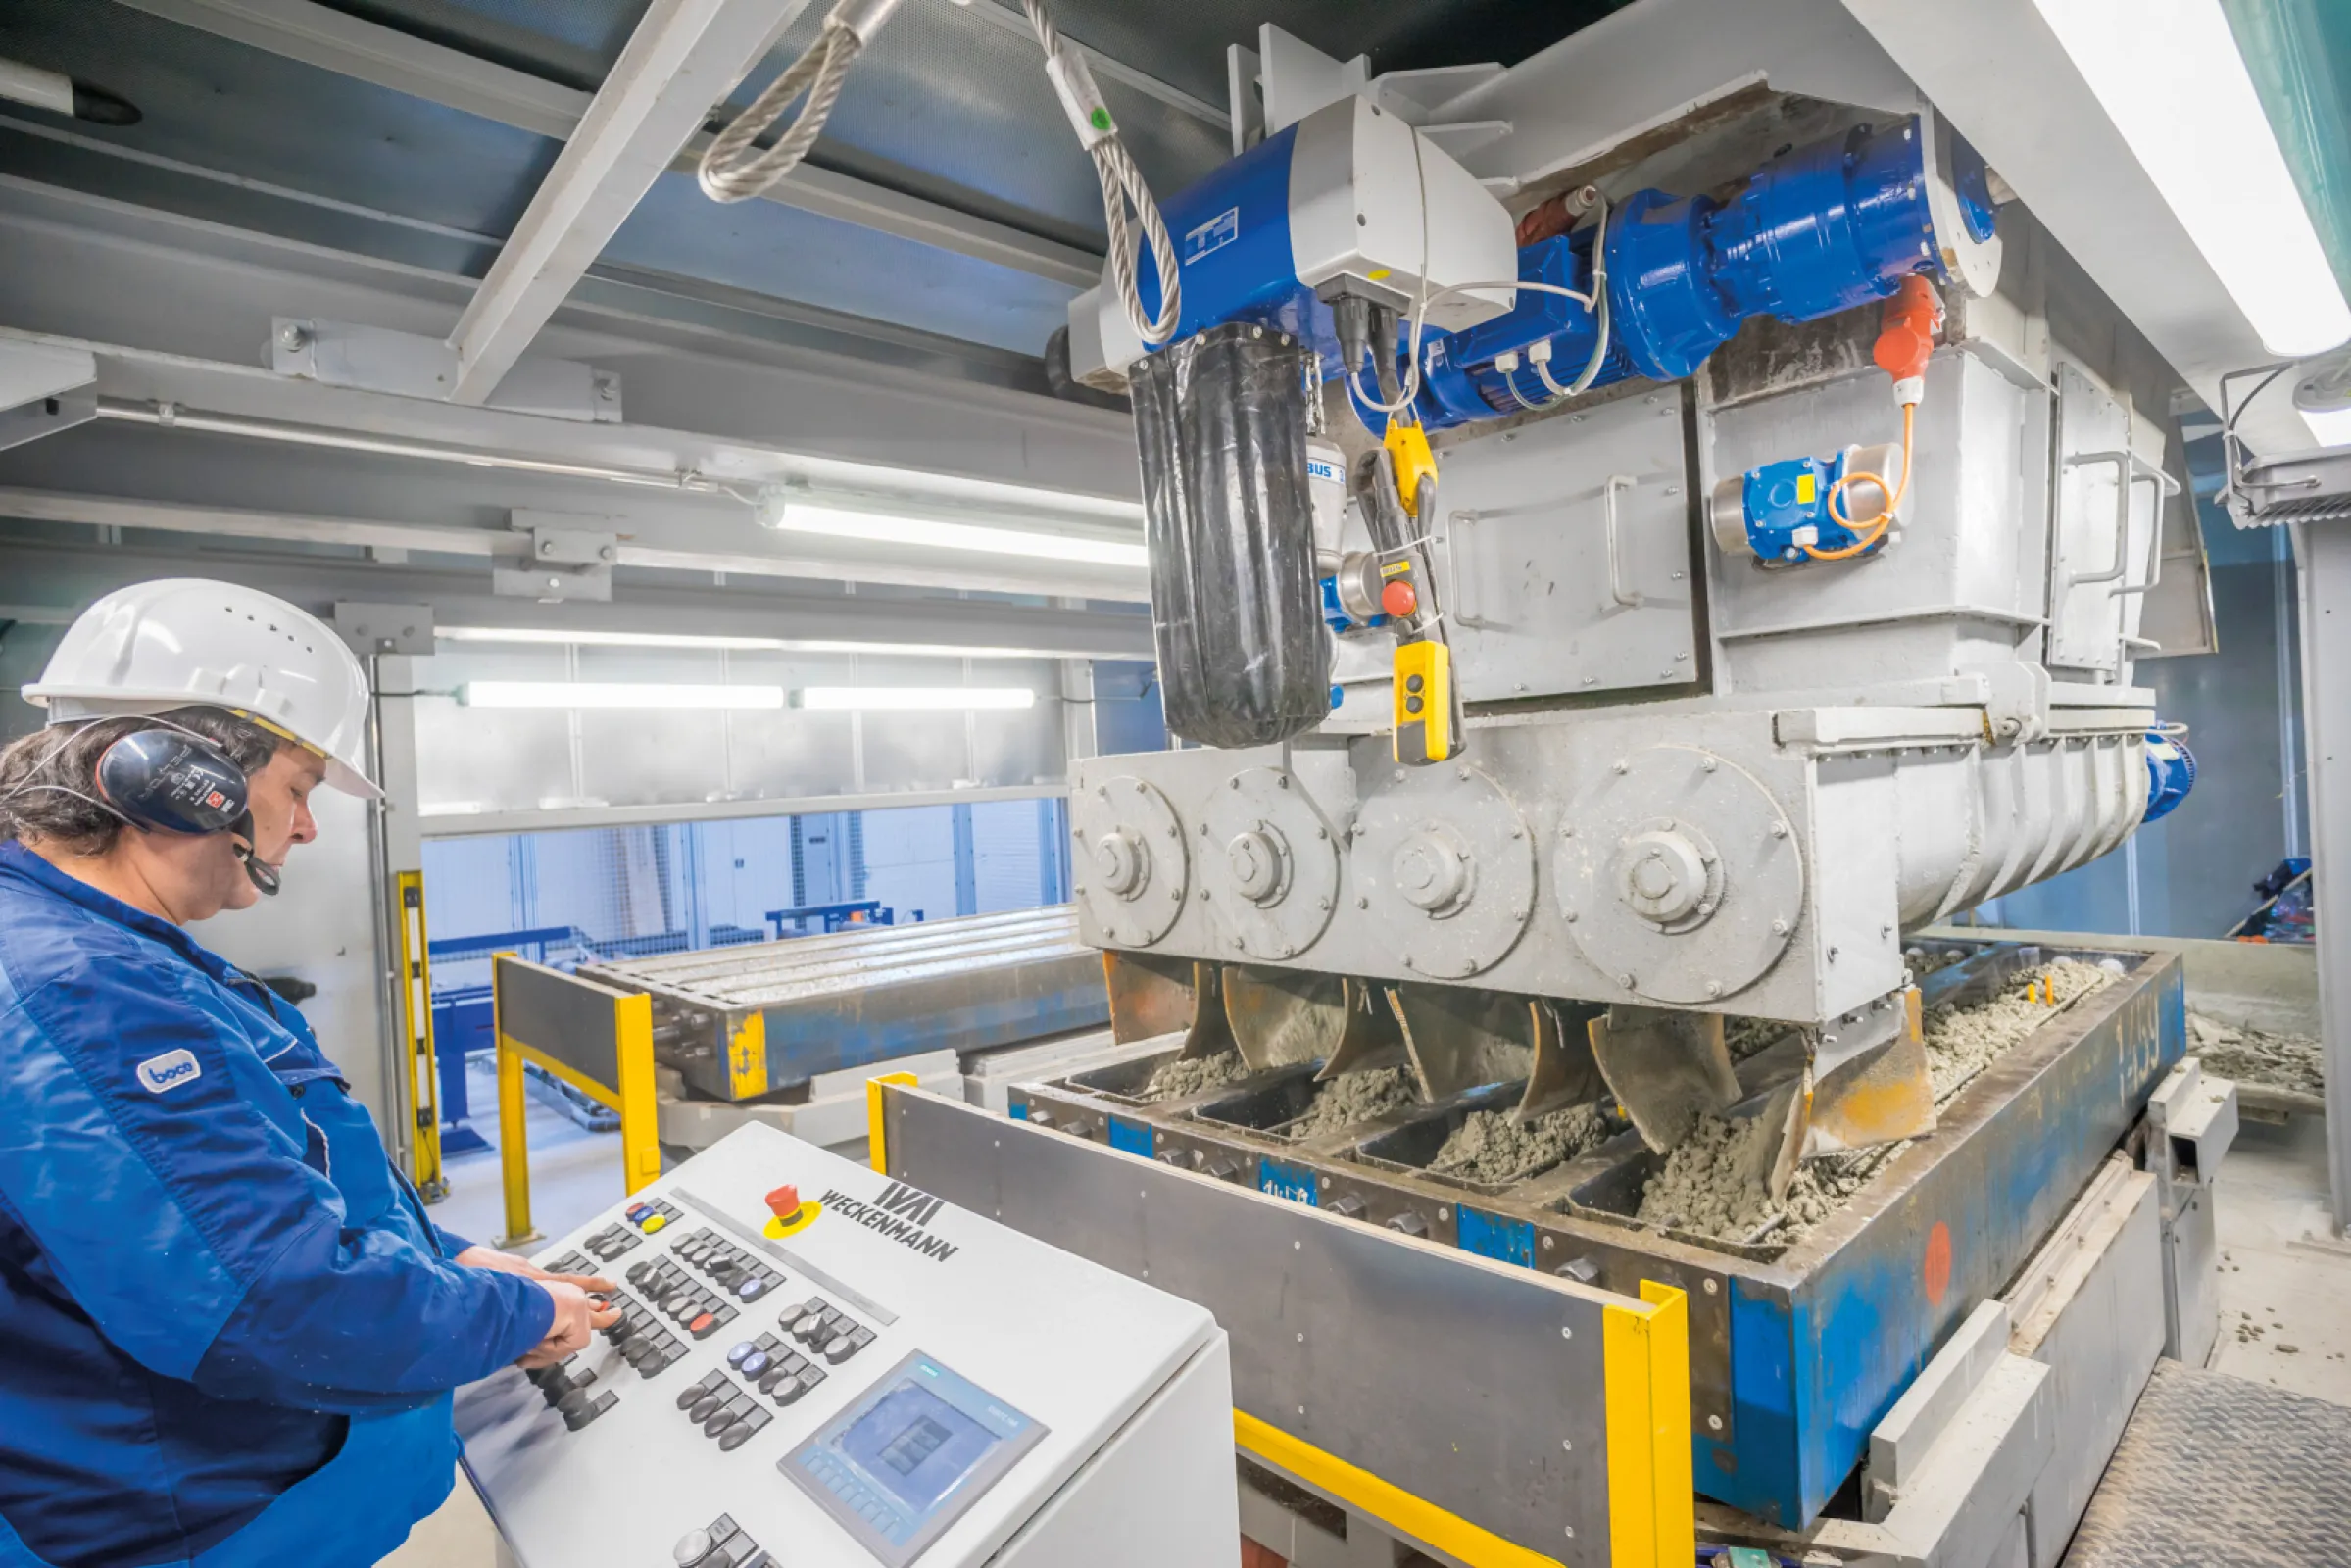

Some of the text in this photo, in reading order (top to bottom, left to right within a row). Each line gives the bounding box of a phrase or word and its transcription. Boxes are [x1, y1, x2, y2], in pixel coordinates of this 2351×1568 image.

[1307, 462, 1332, 478] BUS
[148, 1061, 193, 1084] boco
[817, 1188, 960, 1263] WECKENMANN
